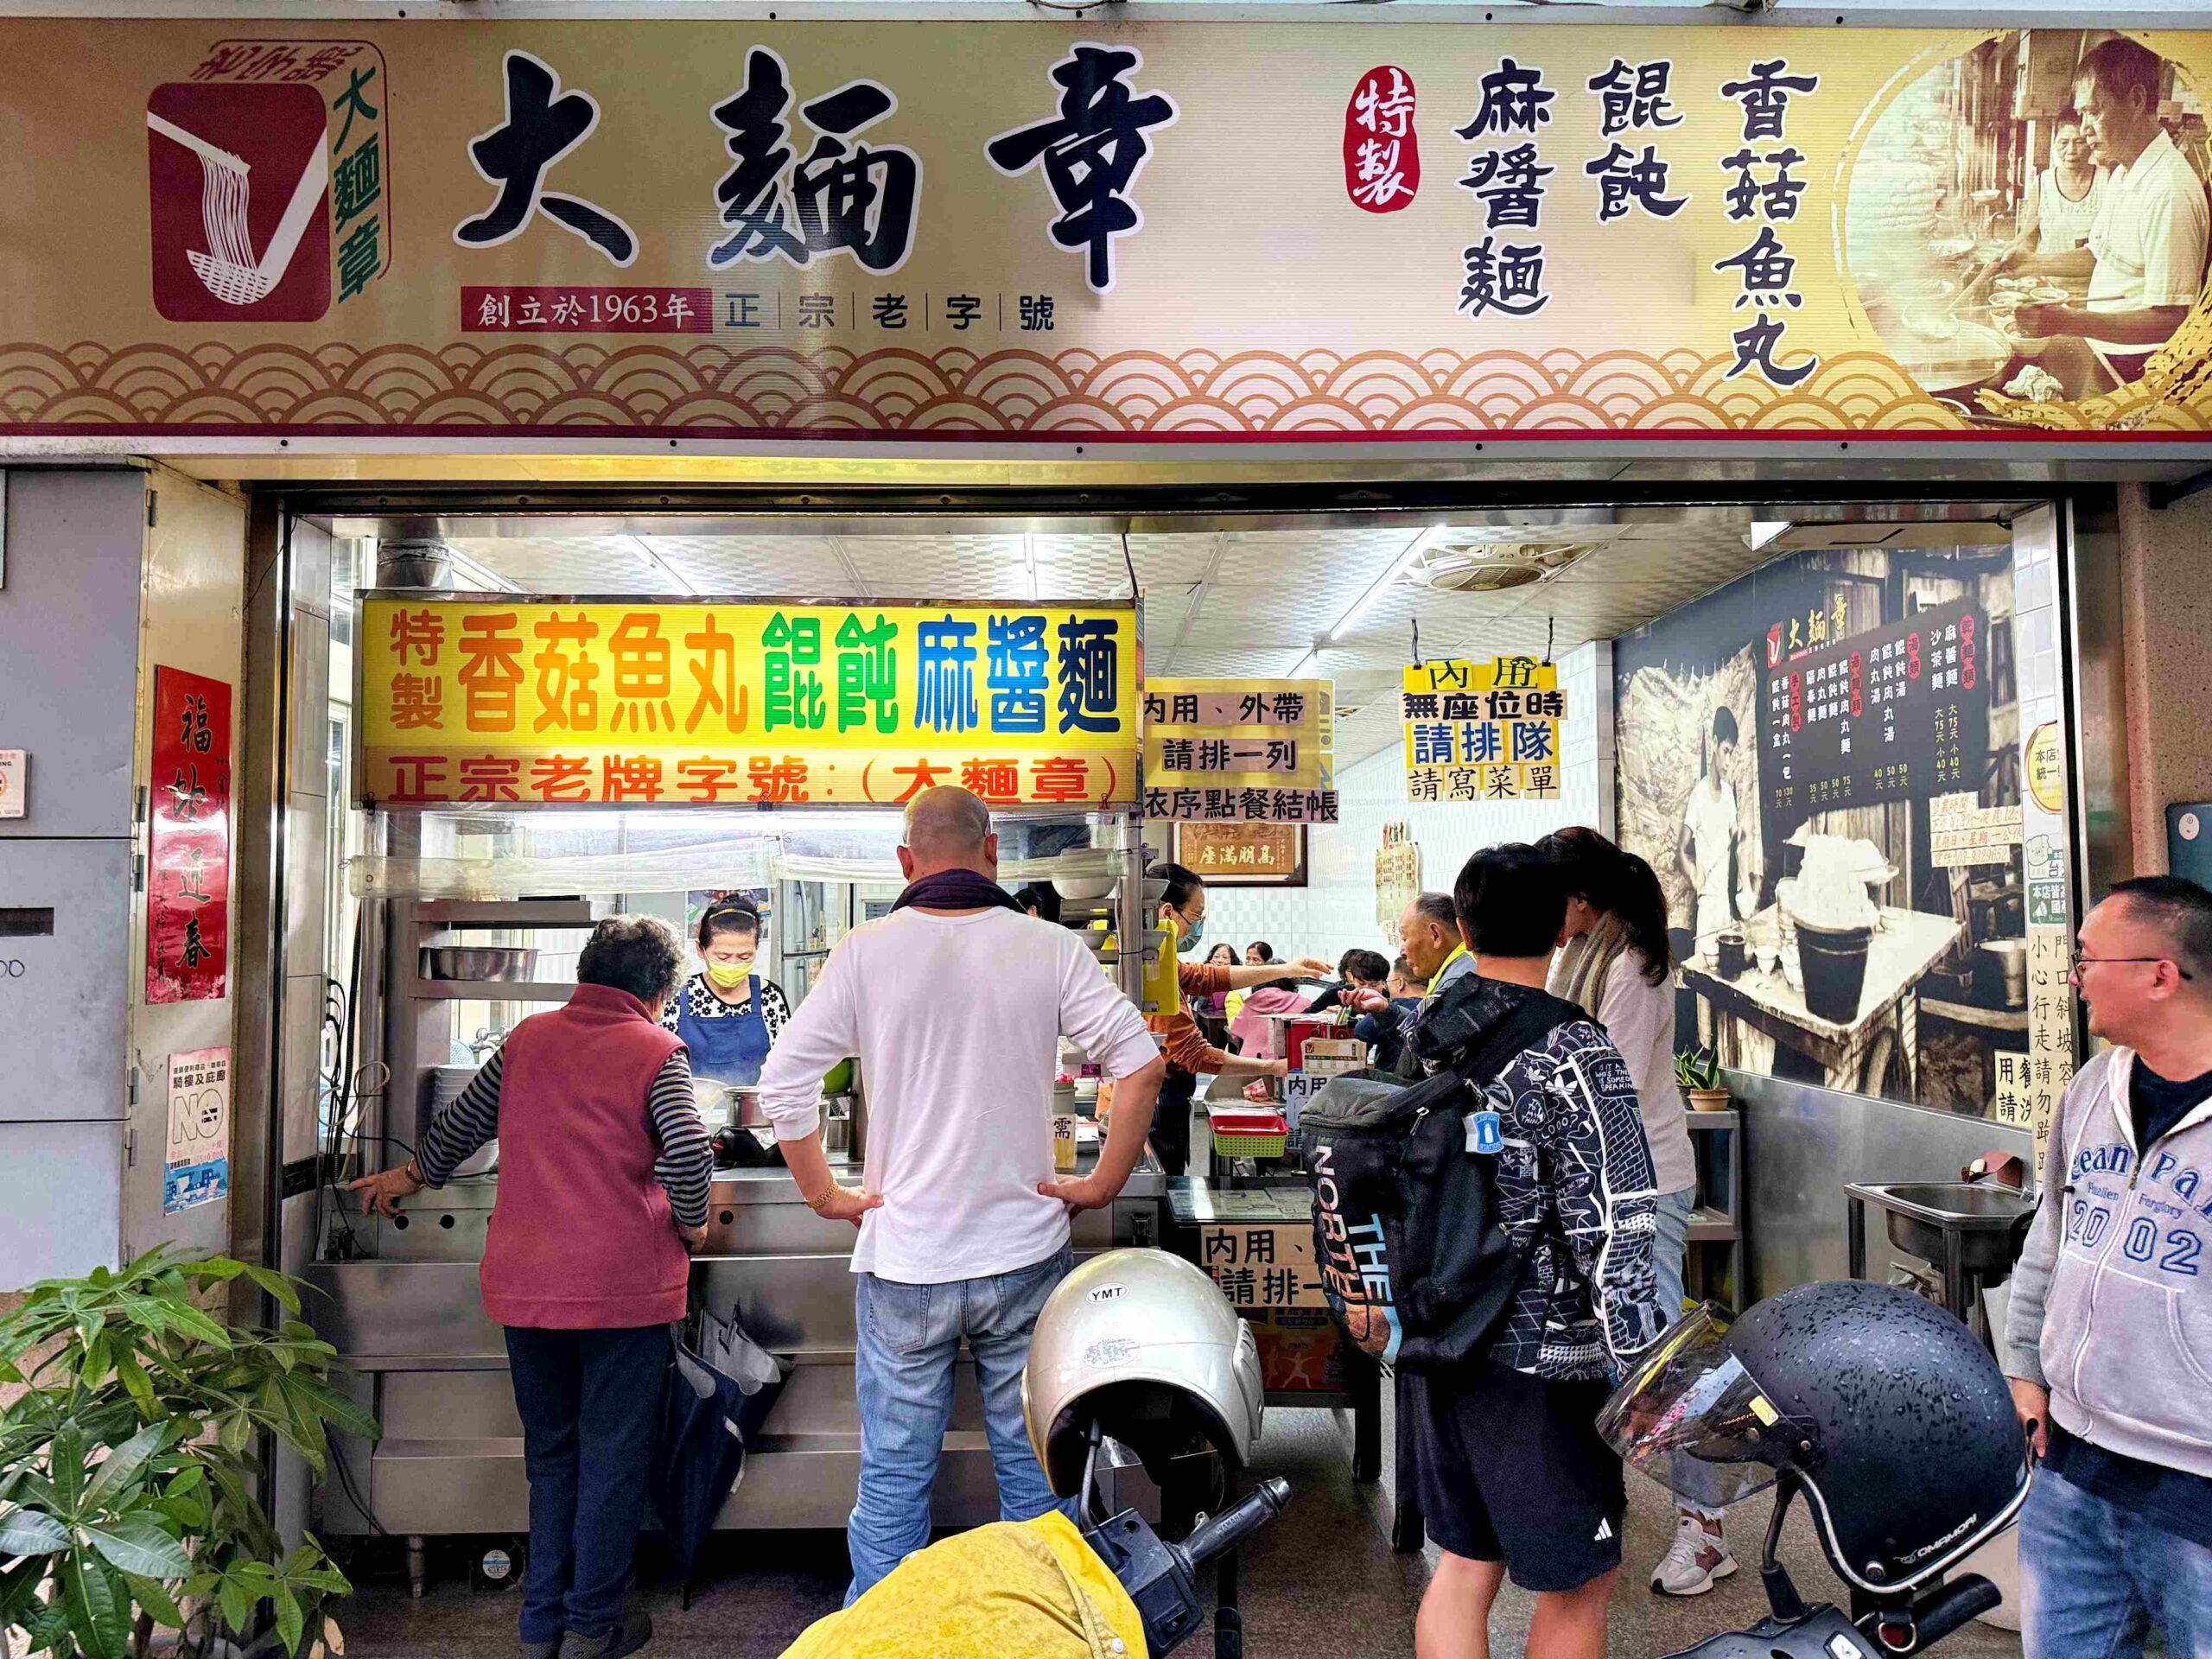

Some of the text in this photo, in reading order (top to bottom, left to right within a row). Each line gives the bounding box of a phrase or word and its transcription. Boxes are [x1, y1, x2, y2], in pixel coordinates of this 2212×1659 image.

[453, 41, 1180, 296] 大麵章
[1353, 67, 1417, 205] 特製
[1584, 58, 1691, 224] 餛飩
[334, 66, 381, 304] 大麵章
[1453, 57, 1555, 320] 麻醬麵
[1712, 58, 1819, 387] 香菇魚丸
[477, 293, 696, 329] 創立於1963年
[390, 607, 445, 730] 特製
[1402, 690, 1564, 721] 無座位時
[1162, 739, 1296, 771] 請排一列
[1408, 765, 1558, 803] 請寫菜單
[1414, 721, 1554, 765] 請排隊
[2035, 747, 2060, 763] 本店
[2036, 766, 2060, 781] 統一
[1314, 1145, 1367, 1300] NORTH
[1347, 1212, 1394, 1302] THE
[1091, 1287, 1123, 1301] YMT
